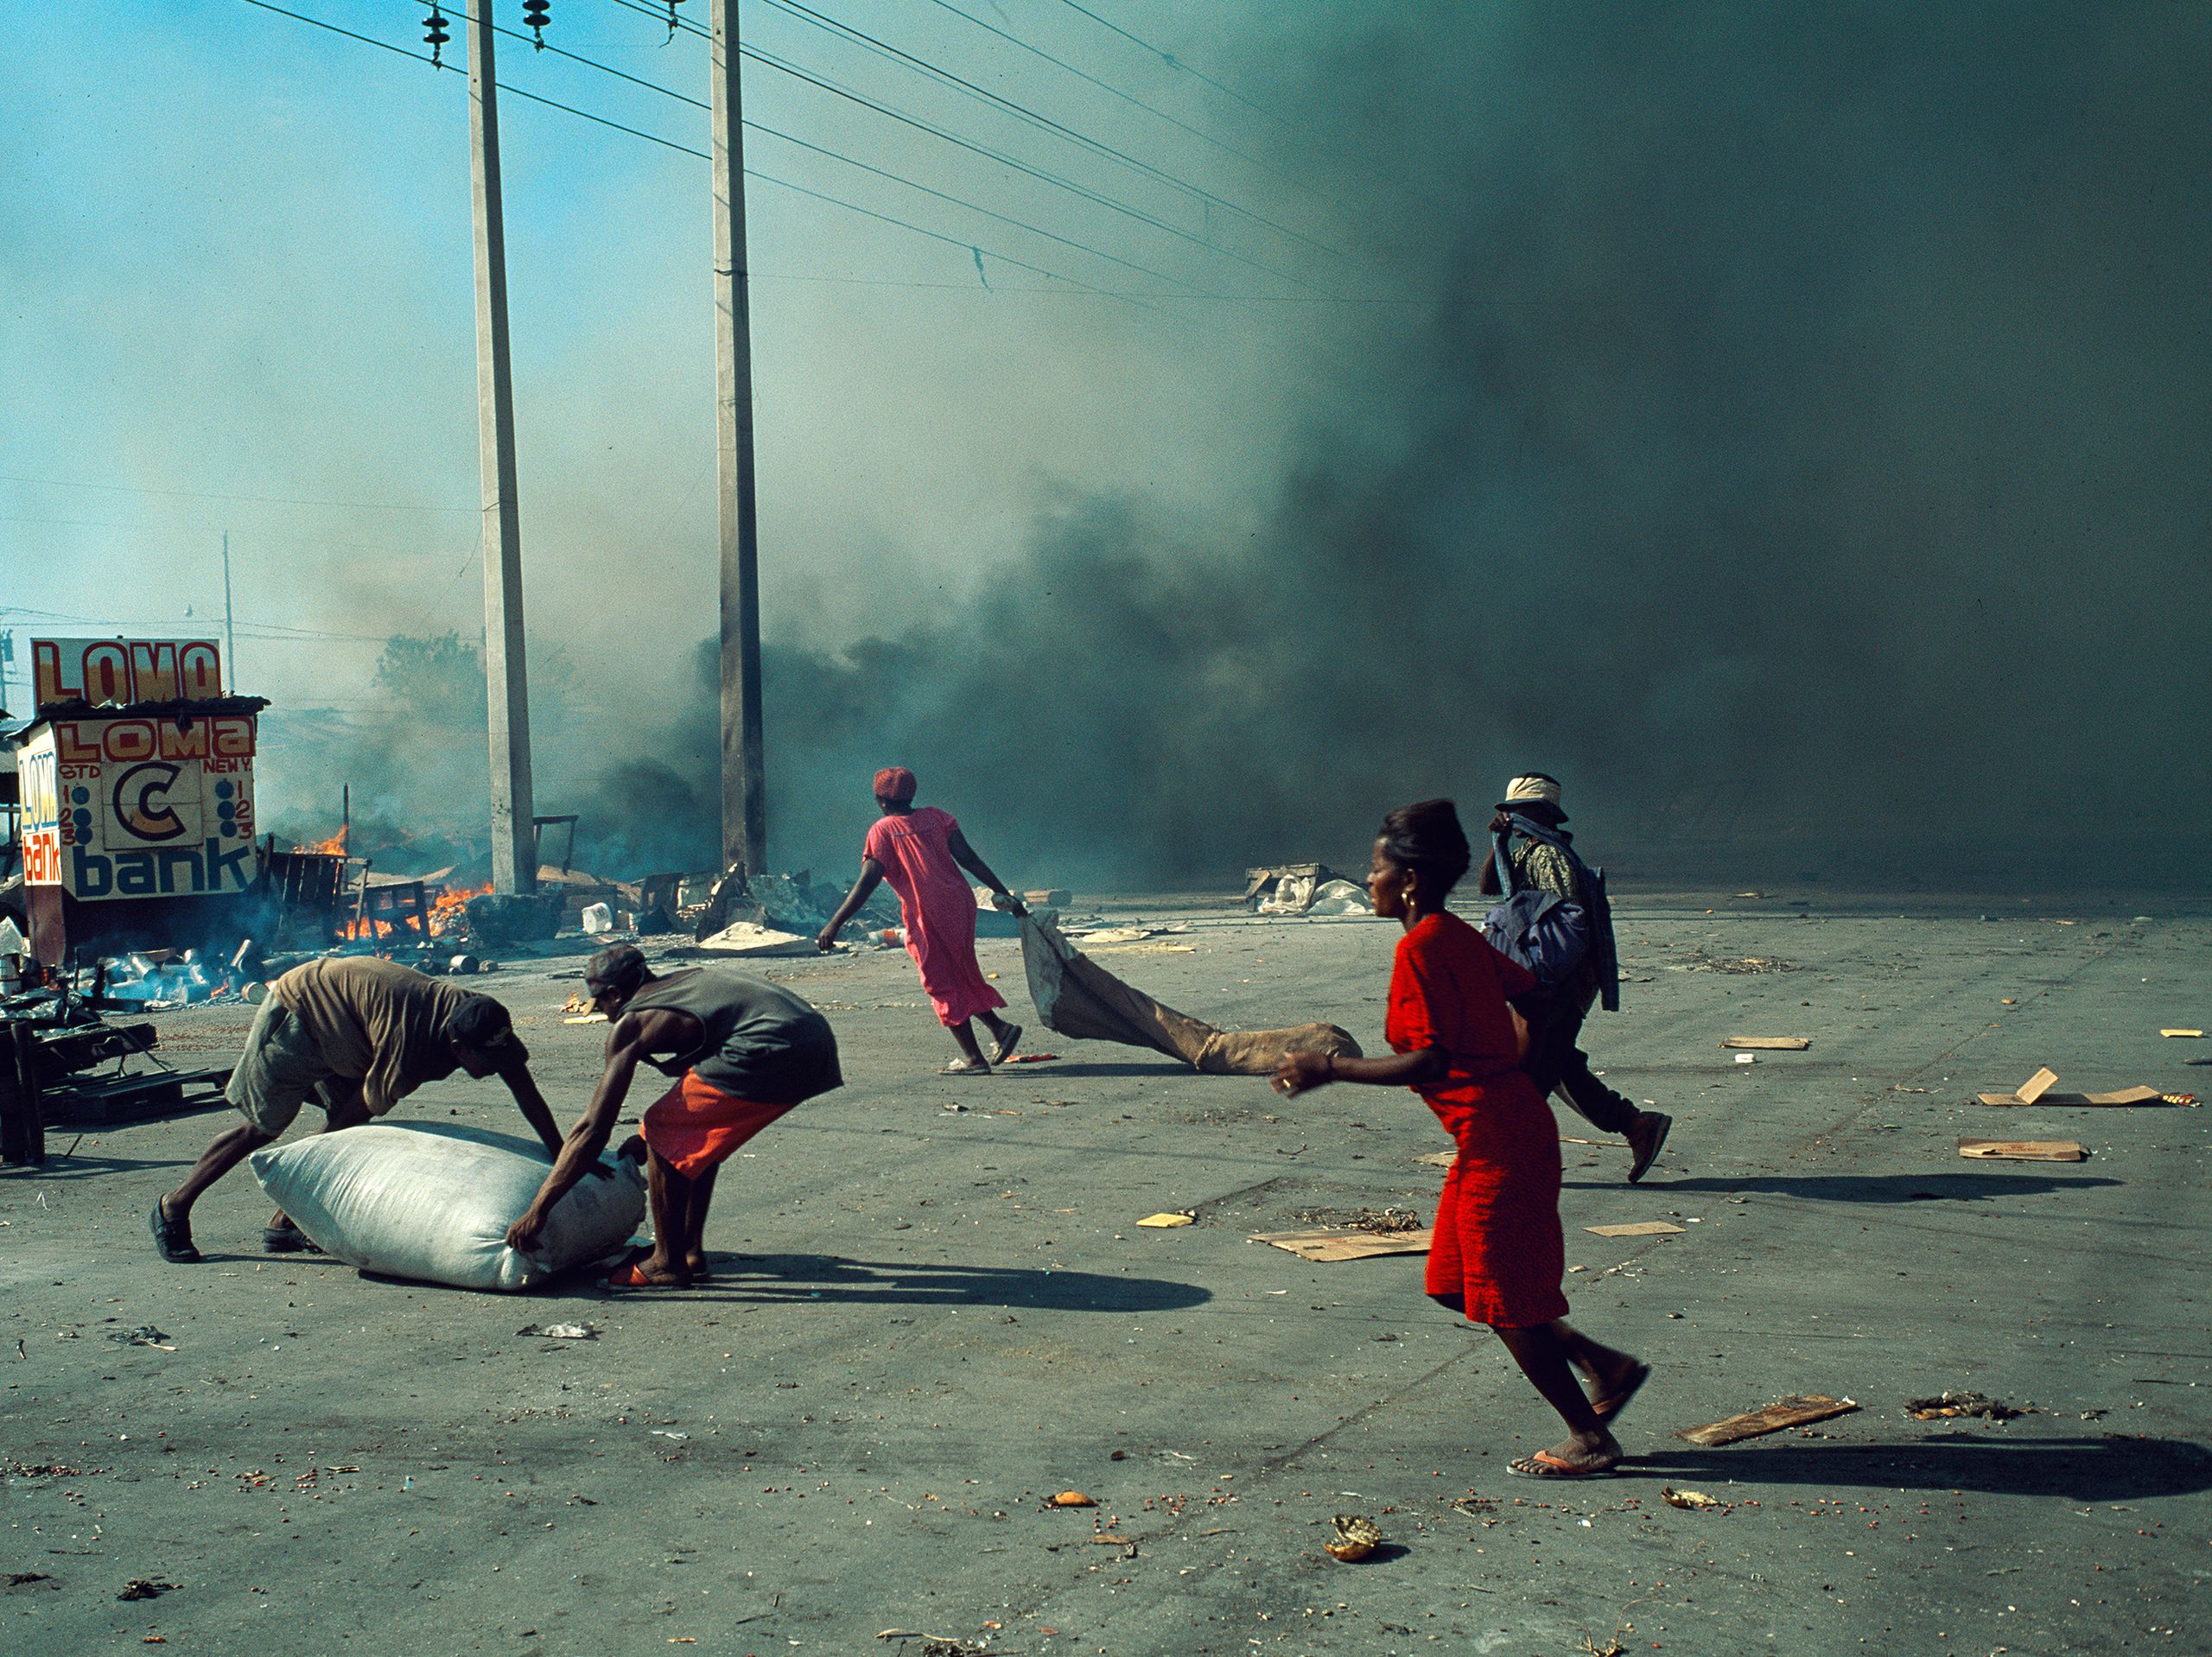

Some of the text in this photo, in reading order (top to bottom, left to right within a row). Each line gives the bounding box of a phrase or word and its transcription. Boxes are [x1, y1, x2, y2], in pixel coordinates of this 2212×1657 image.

[59, 765, 101, 779] STD
[204, 758, 238, 774] NEW
[63, 784, 70, 804] 1
[238, 780, 243, 799] 1
[112, 761, 187, 841] C
[234, 799, 251, 819] 2
[59, 807, 74, 828] 2
[60, 828, 76, 846] 3
[237, 822, 253, 840] 3
[23, 832, 61, 882] bank
[73, 837, 250, 898] bank
